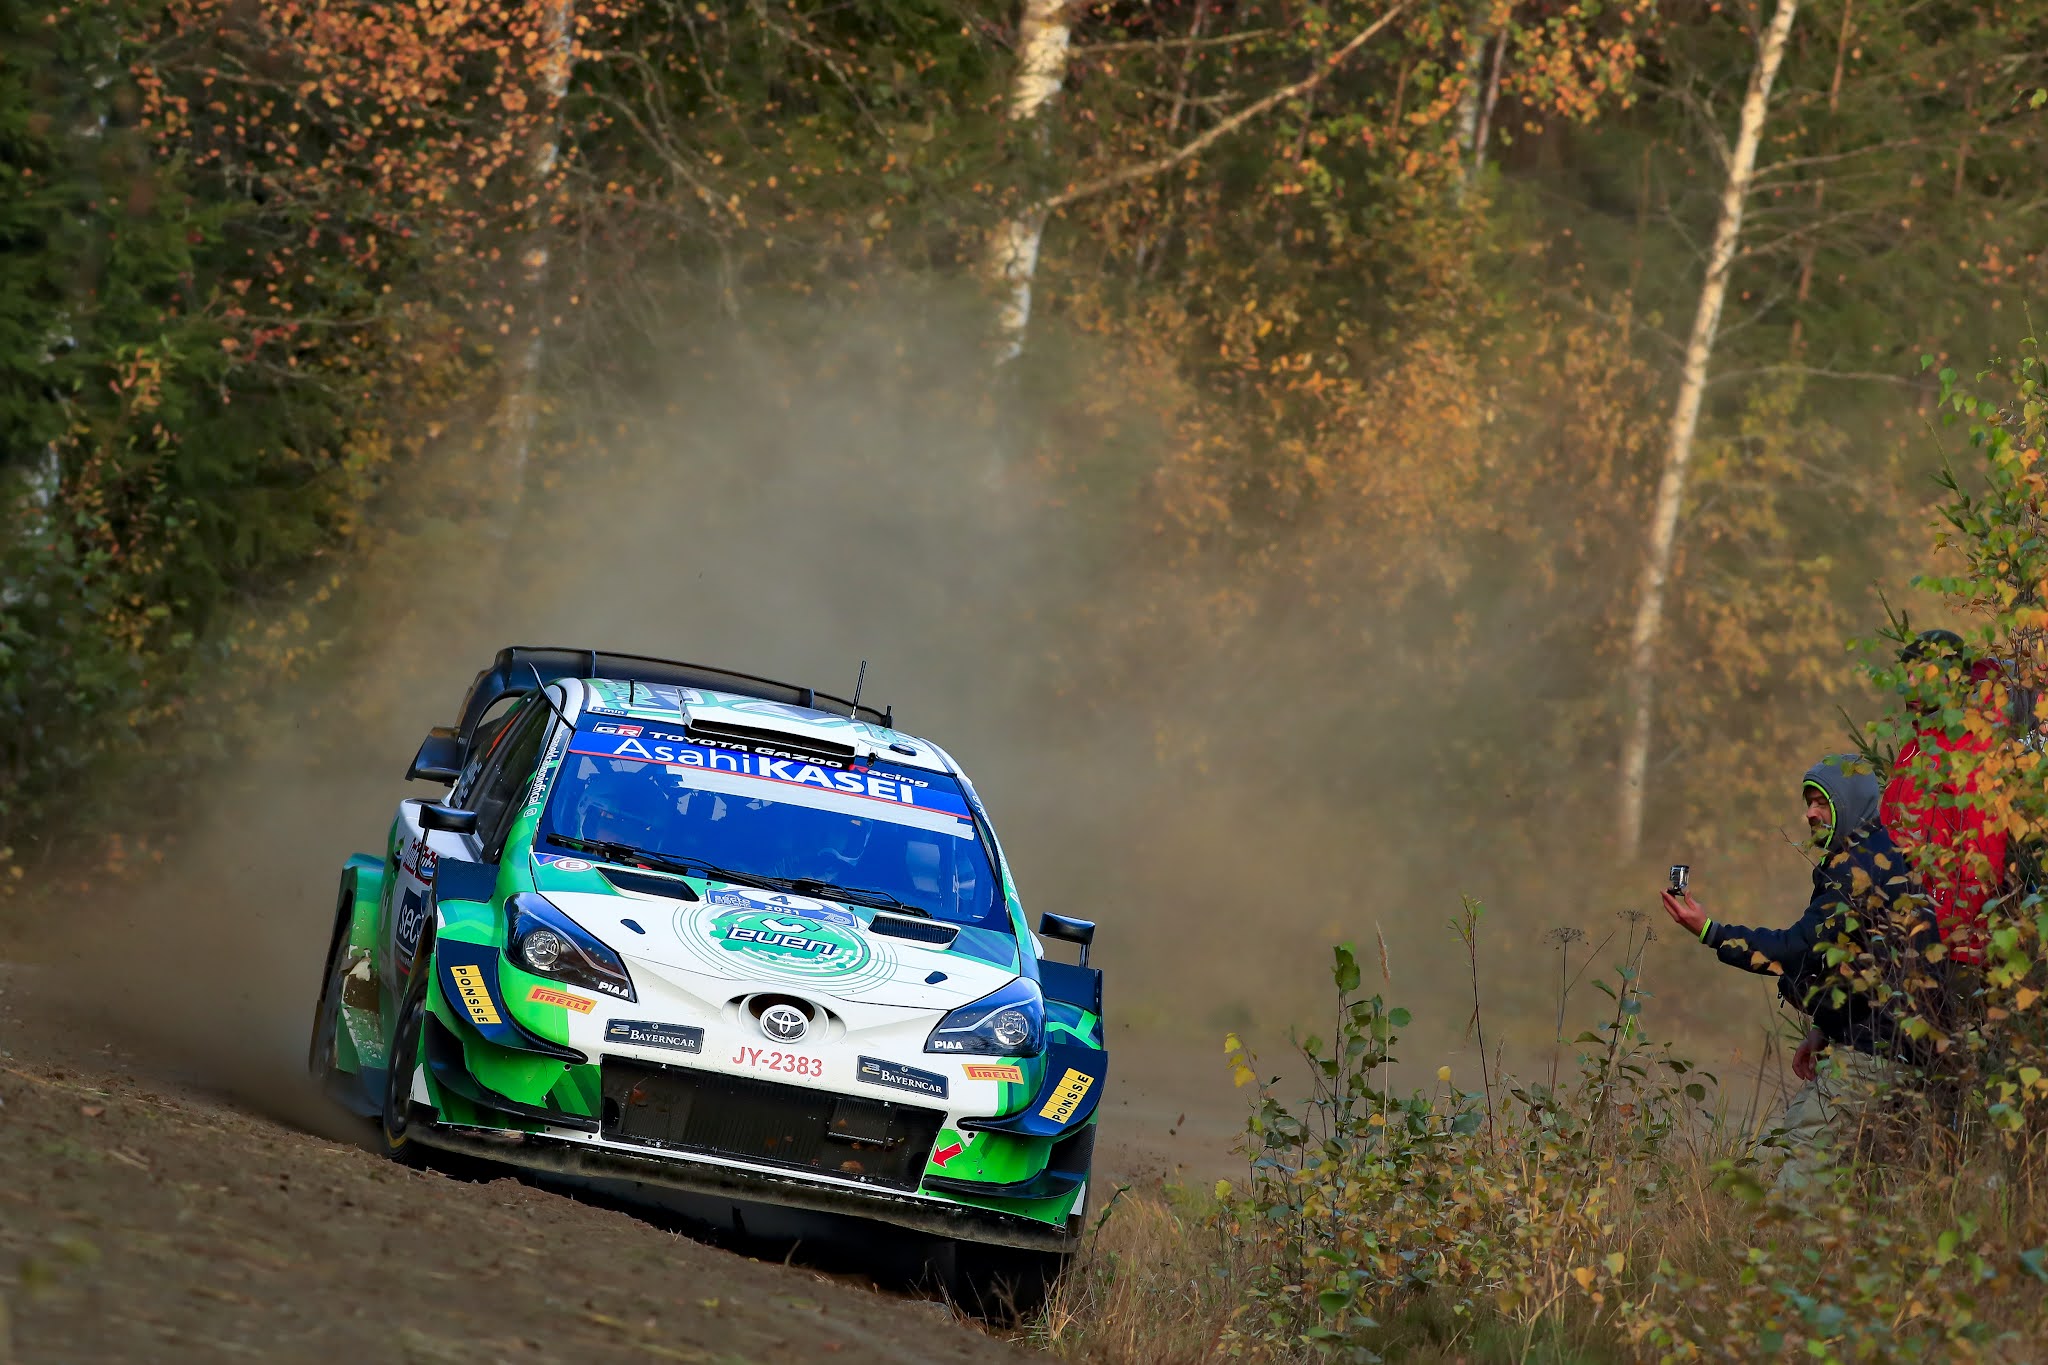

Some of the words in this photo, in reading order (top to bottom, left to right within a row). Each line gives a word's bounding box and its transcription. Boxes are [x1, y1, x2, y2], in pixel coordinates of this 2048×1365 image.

[649, 731, 749, 751] TOYOTA
[754, 746, 843, 769] GAZOO
[849, 763, 929, 788] Racing
[764, 905, 800, 916] 2021
[769, 895, 792, 906] 4
[398, 903, 422, 944] sec
[455, 967, 489, 1023] PONSSE
[531, 988, 592, 1011] PIRELLI
[597, 981, 630, 998] PIAA
[934, 1040, 964, 1050] PIAA
[732, 1046, 823, 1077] JY-2383
[967, 1066, 1020, 1081] PIRELLI
[1051, 1074, 1090, 1122] PONSSE
